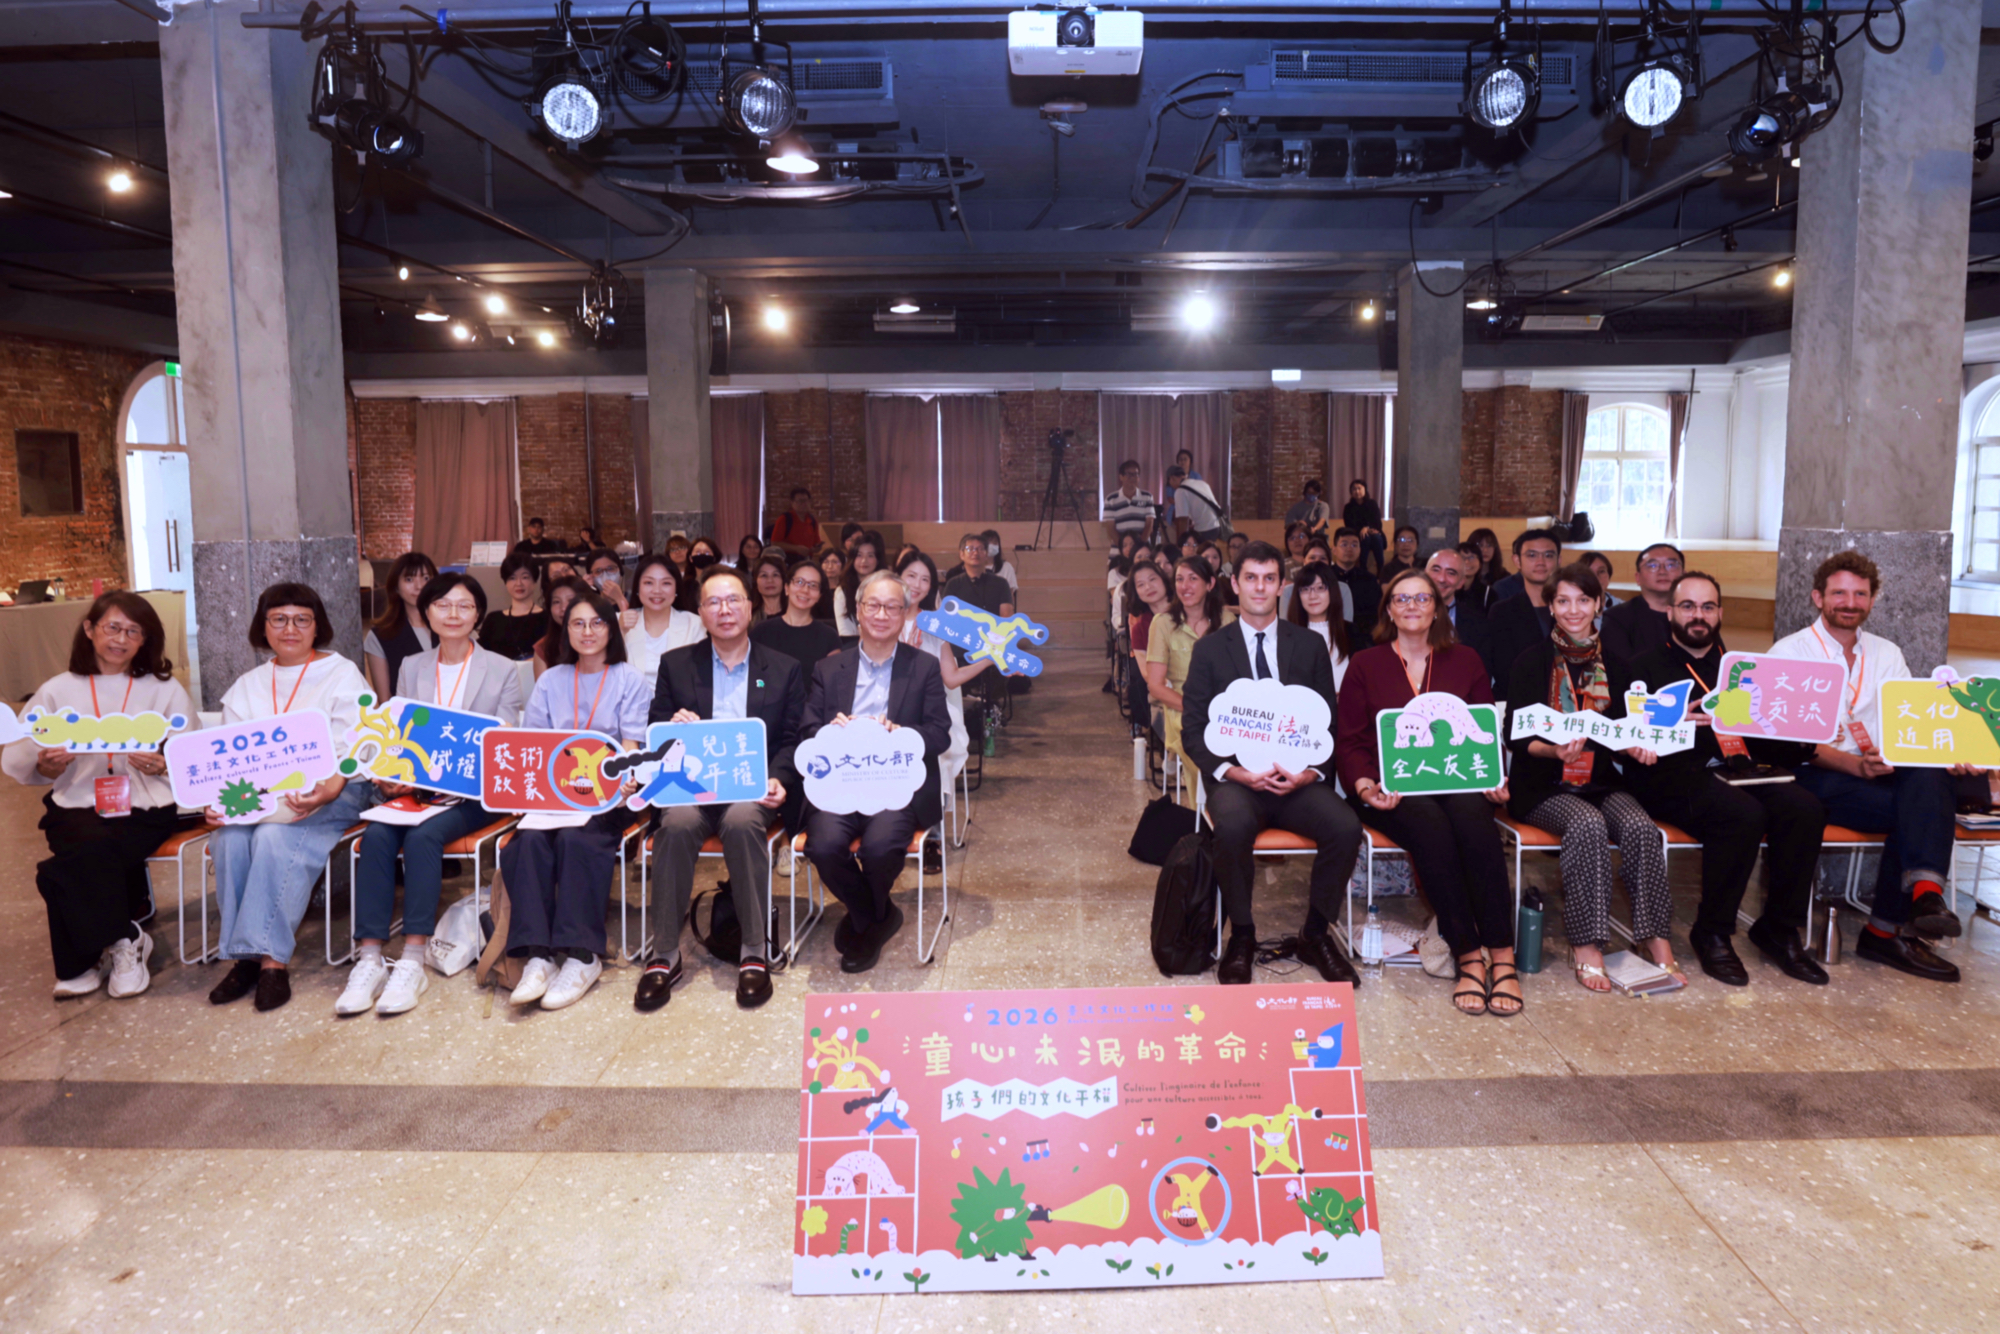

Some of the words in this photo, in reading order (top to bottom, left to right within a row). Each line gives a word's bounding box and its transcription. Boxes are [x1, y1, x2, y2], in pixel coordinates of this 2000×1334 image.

[1773, 672, 1832, 693] 文化
[1231, 705, 1275, 721] BUREAU
[1768, 697, 1827, 727] 交流
[1896, 700, 1959, 720] 文化
[440, 721, 482, 745] 文化
[1217, 714, 1273, 732] FRANÇAIS
[1220, 726, 1234, 737] DE
[1237, 729, 1271, 743] TAIPEI
[211, 726, 288, 755] 2026
[702, 731, 758, 758] 兒童
[1895, 726, 1955, 752] 近用
[430, 749, 476, 779] 賦權
[493, 742, 543, 772] 藝術
[835, 750, 914, 769] 文化部
[1392, 752, 1489, 781] 全人友善
[702, 760, 757, 792] 平權
[986, 1007, 1059, 1026] 2026
[920, 1031, 1247, 1077] 童心未泯的革命
[1123, 1082, 1156, 1092] Cultiver
[1210, 1080, 1221, 1089] de
[1165, 1095, 1195, 1103] culture
